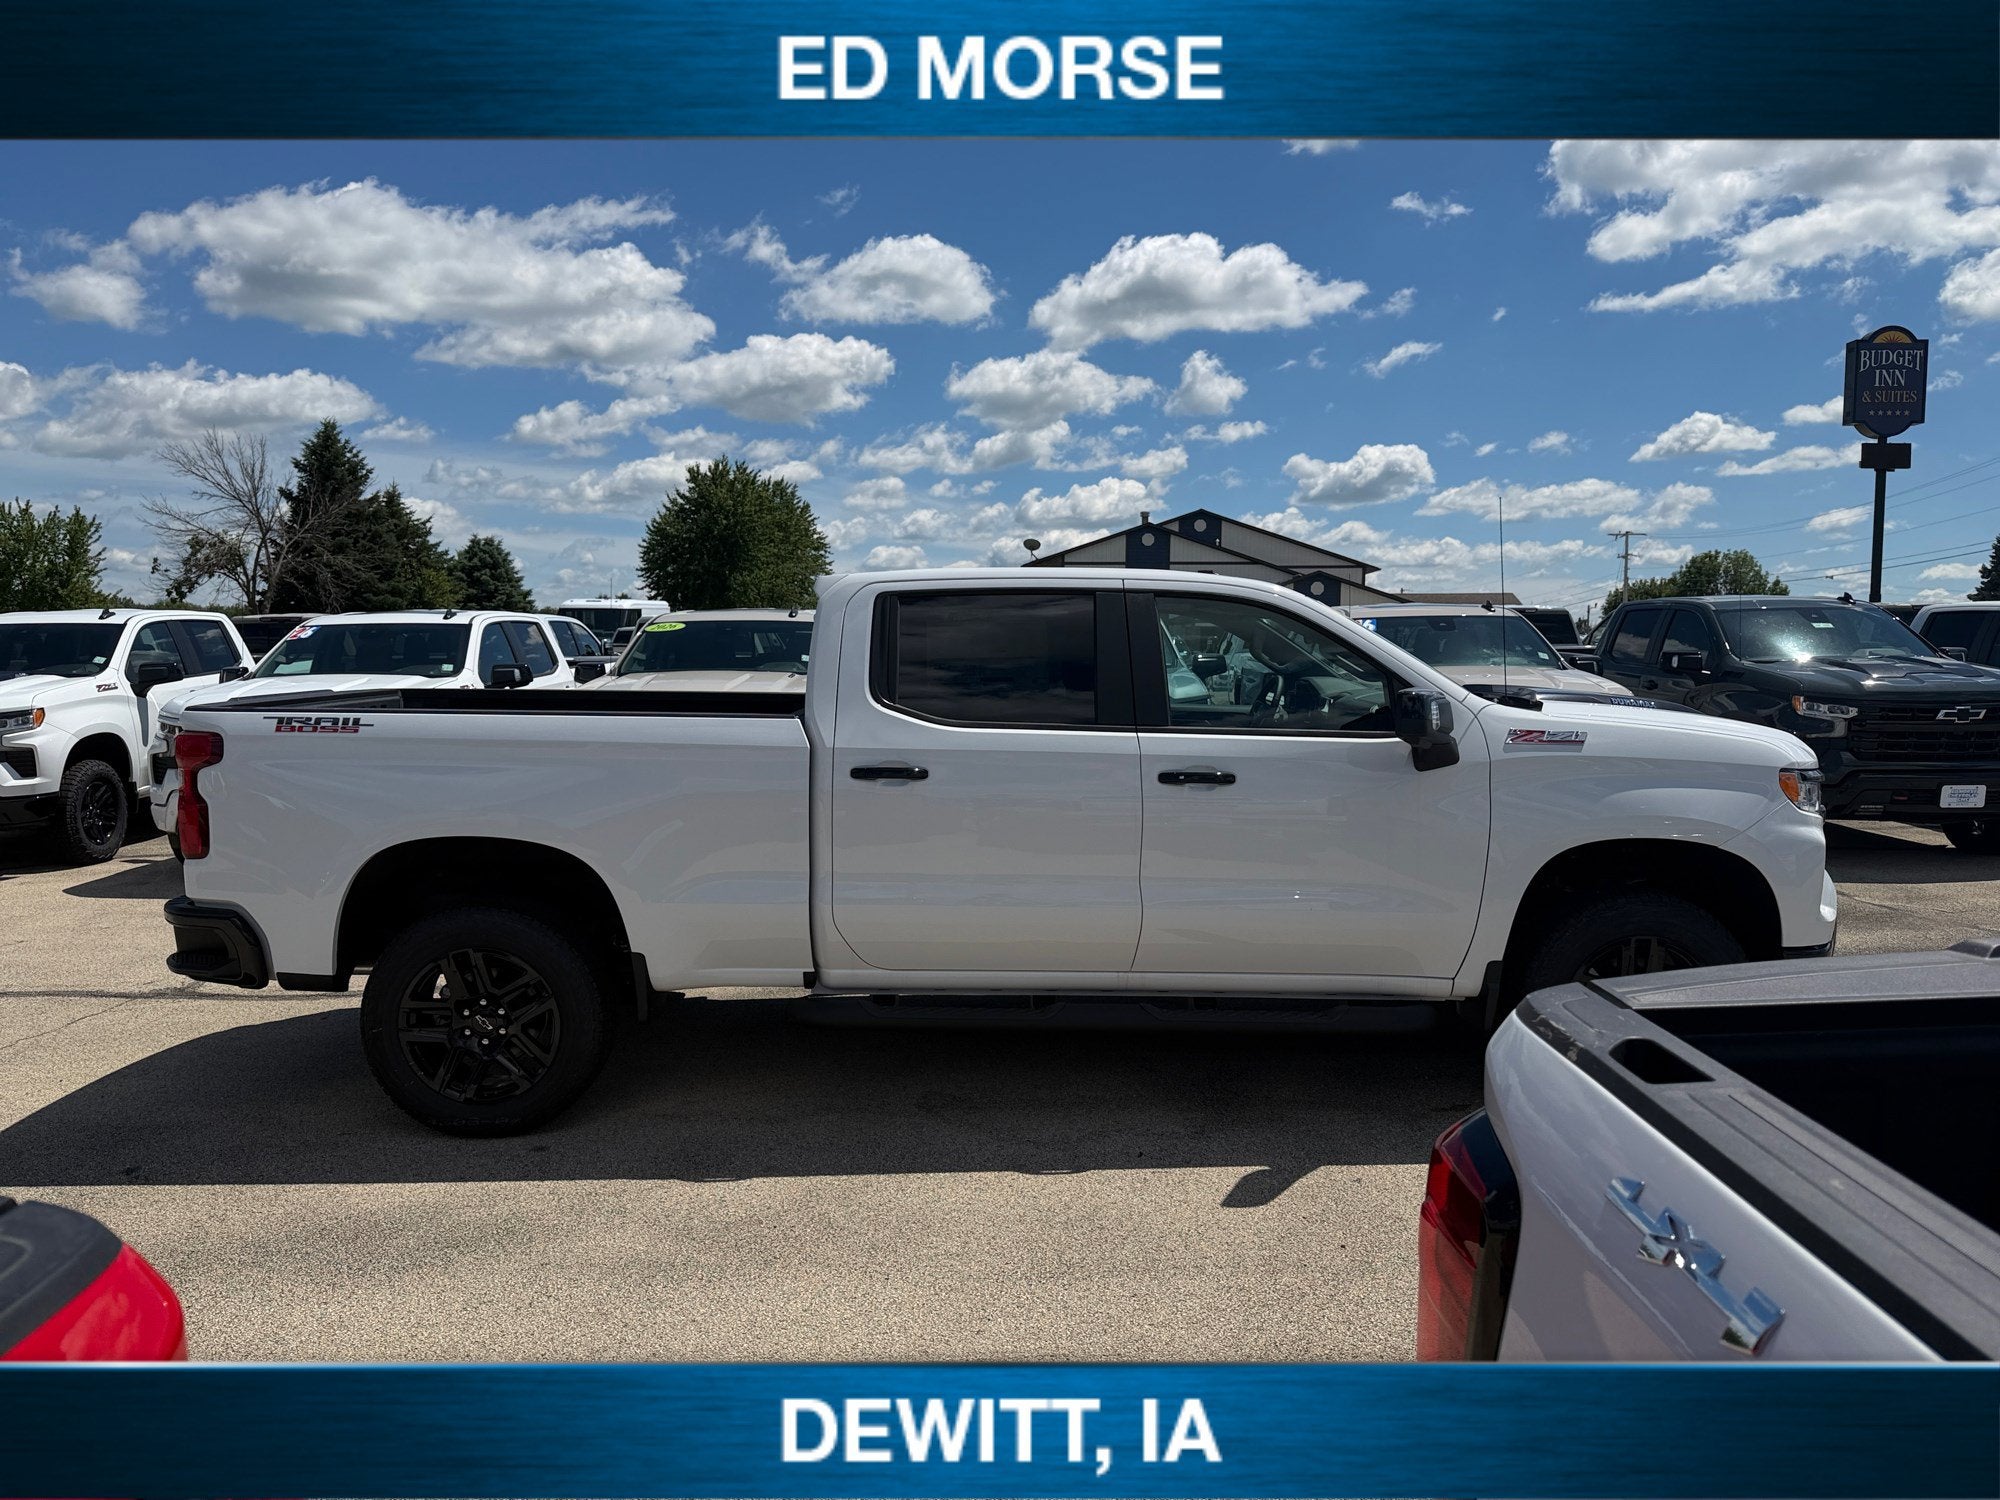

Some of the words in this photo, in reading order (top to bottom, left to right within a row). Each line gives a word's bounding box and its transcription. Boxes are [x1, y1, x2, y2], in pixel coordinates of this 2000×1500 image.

[1860, 349, 1923, 371] BUDGET
[1874, 369, 1907, 387] INN
[1862, 390, 1872, 403] &
[1875, 390, 1917, 403] SUITES
[1610, 697, 1656, 708] DURAMAX
[263, 716, 374, 726] TRAIL
[275, 725, 360, 733] BOSS
[1505, 728, 1588, 746] Z71
